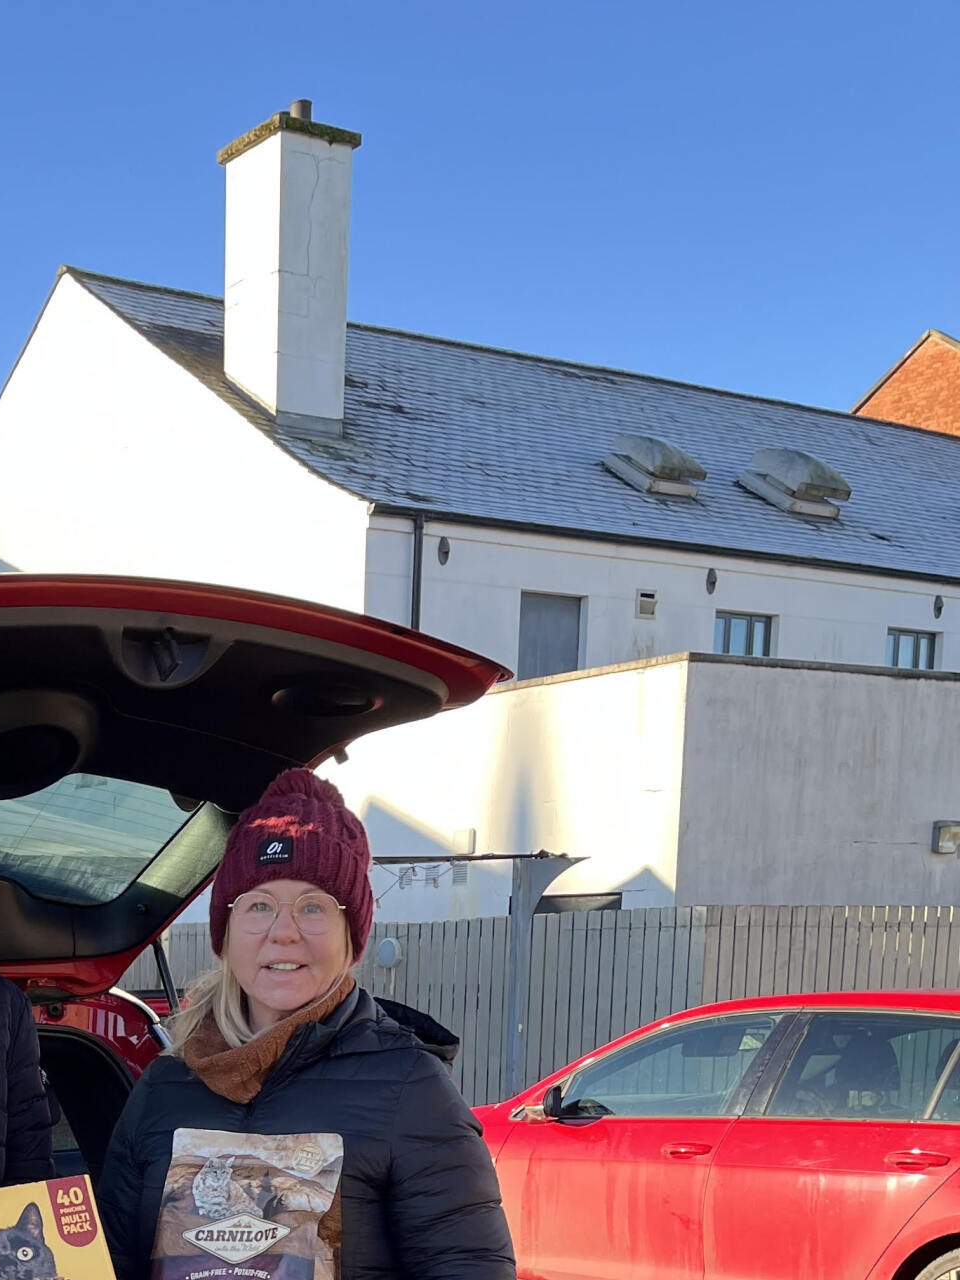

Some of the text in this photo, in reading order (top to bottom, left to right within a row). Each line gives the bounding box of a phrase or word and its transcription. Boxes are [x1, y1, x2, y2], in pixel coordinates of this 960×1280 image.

[56, 1186, 84, 1206] 40
[60, 1212, 90, 1225] MULTI
[62, 1221, 93, 1235] PACK
[194, 1227, 279, 1243] CARNILOVE
